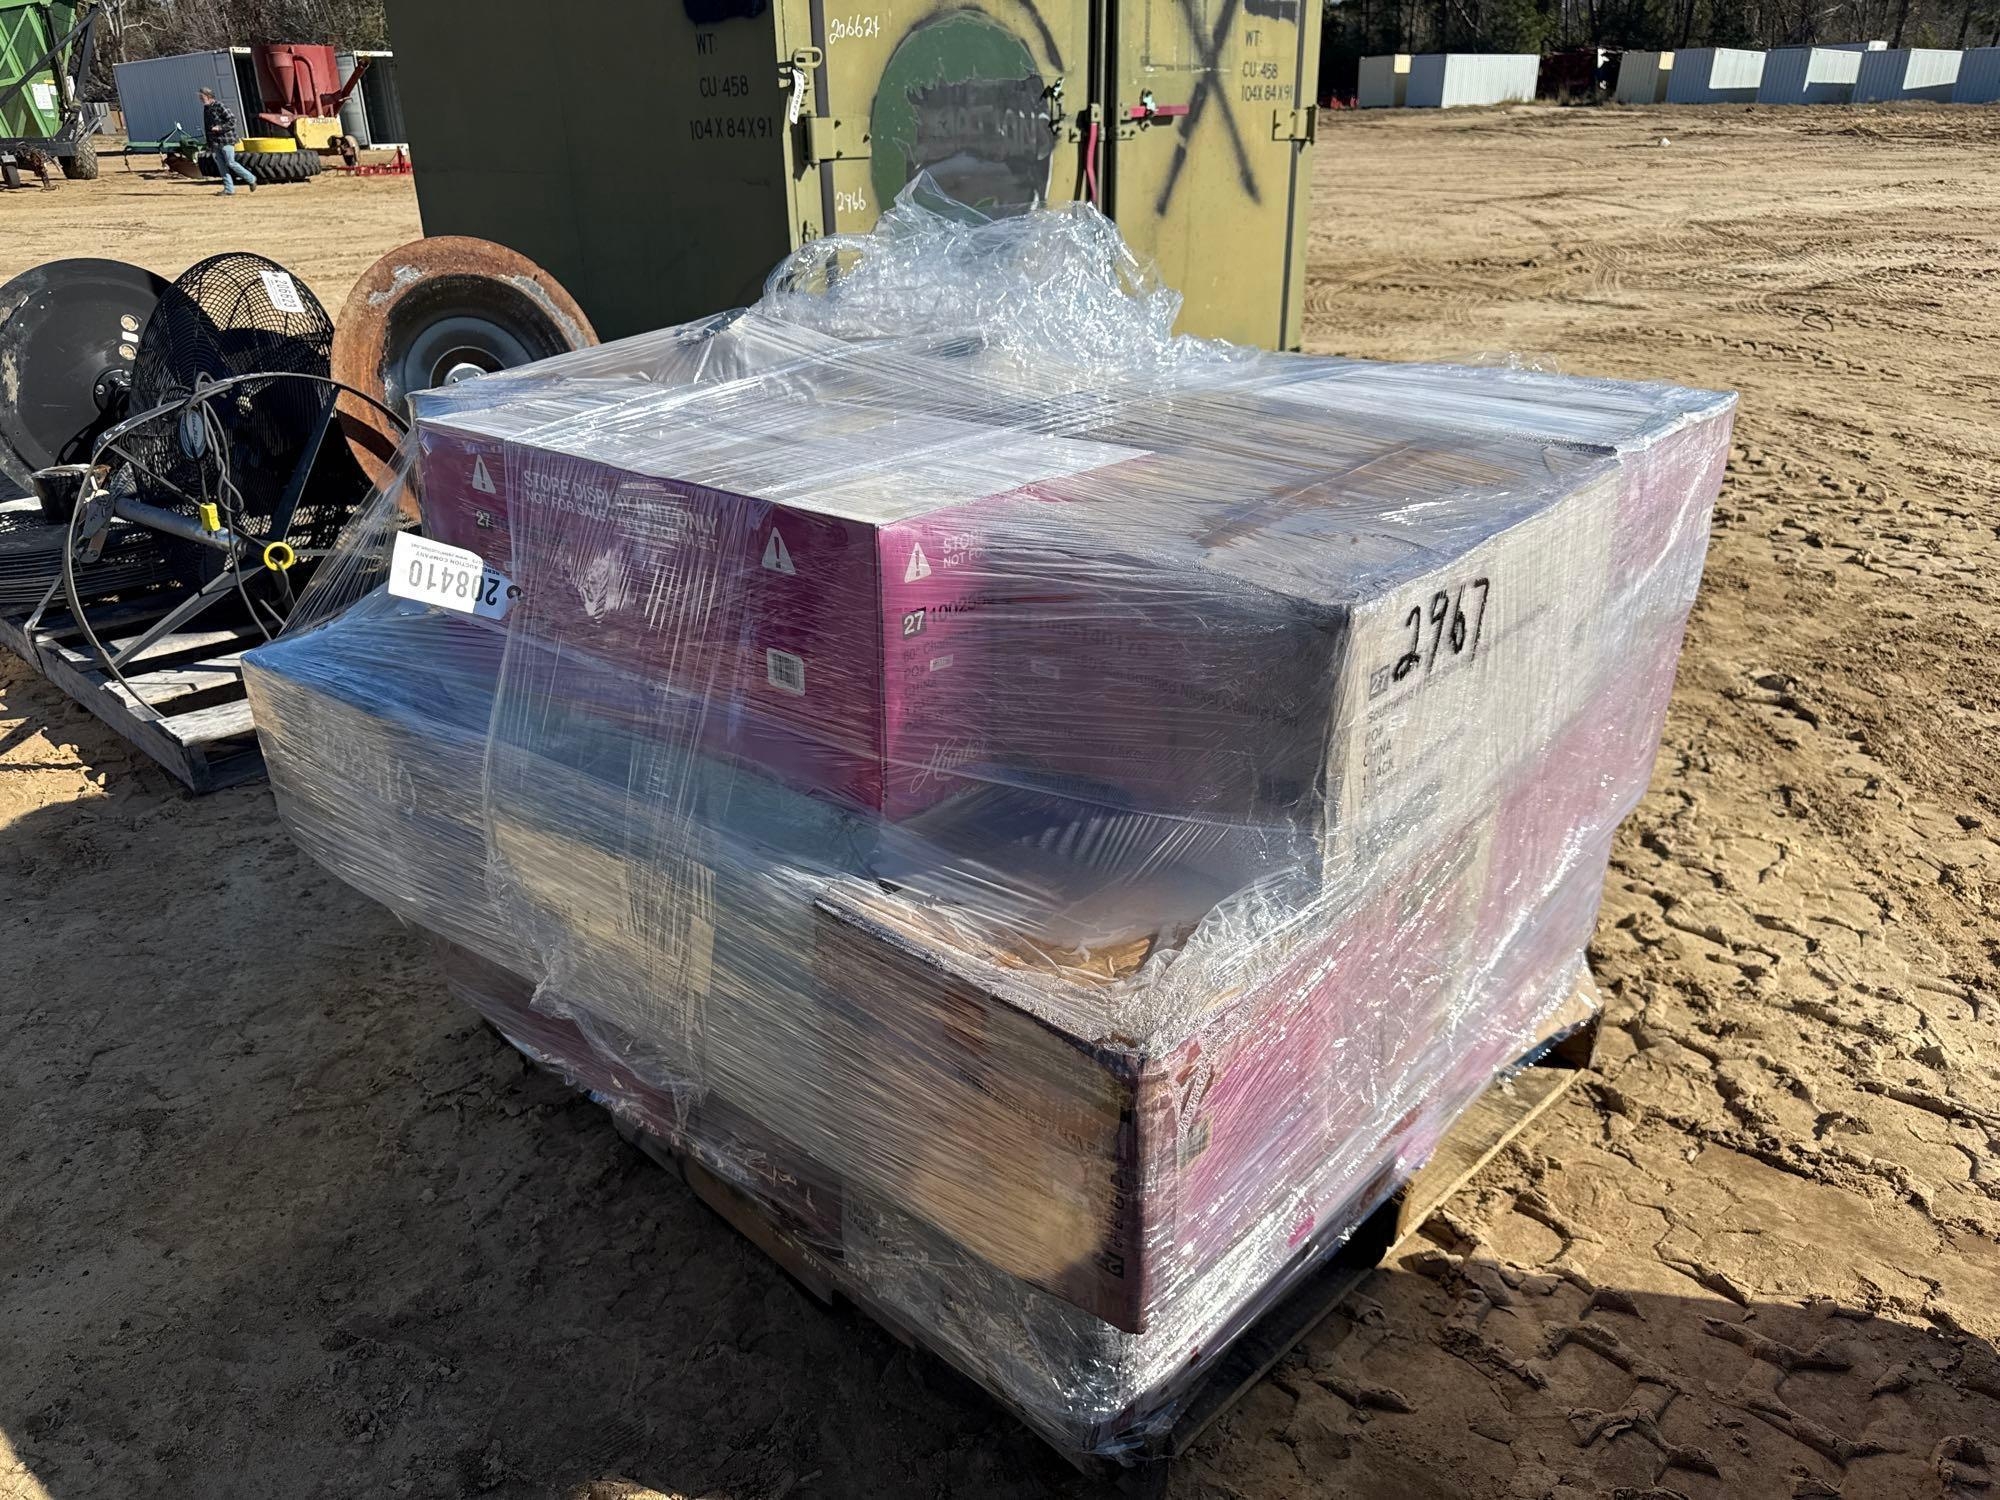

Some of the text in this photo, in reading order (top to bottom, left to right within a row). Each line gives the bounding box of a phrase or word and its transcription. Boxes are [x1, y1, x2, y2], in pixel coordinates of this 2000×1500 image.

[835, 187, 868, 214] 2966
[523, 469, 571, 497] STORE
[526, 489, 550, 506] NOT
[551, 496, 576, 513] FOR
[577, 503, 607, 522] SALE
[415, 550, 449, 564] COMPANY
[449, 558, 479, 571] AUCTION
[942, 551, 966, 569] NOT
[408, 559, 501, 607] 208410
[903, 610, 925, 635] 27
[1392, 577, 1491, 683] 2967
[1370, 668, 1388, 698] 27
